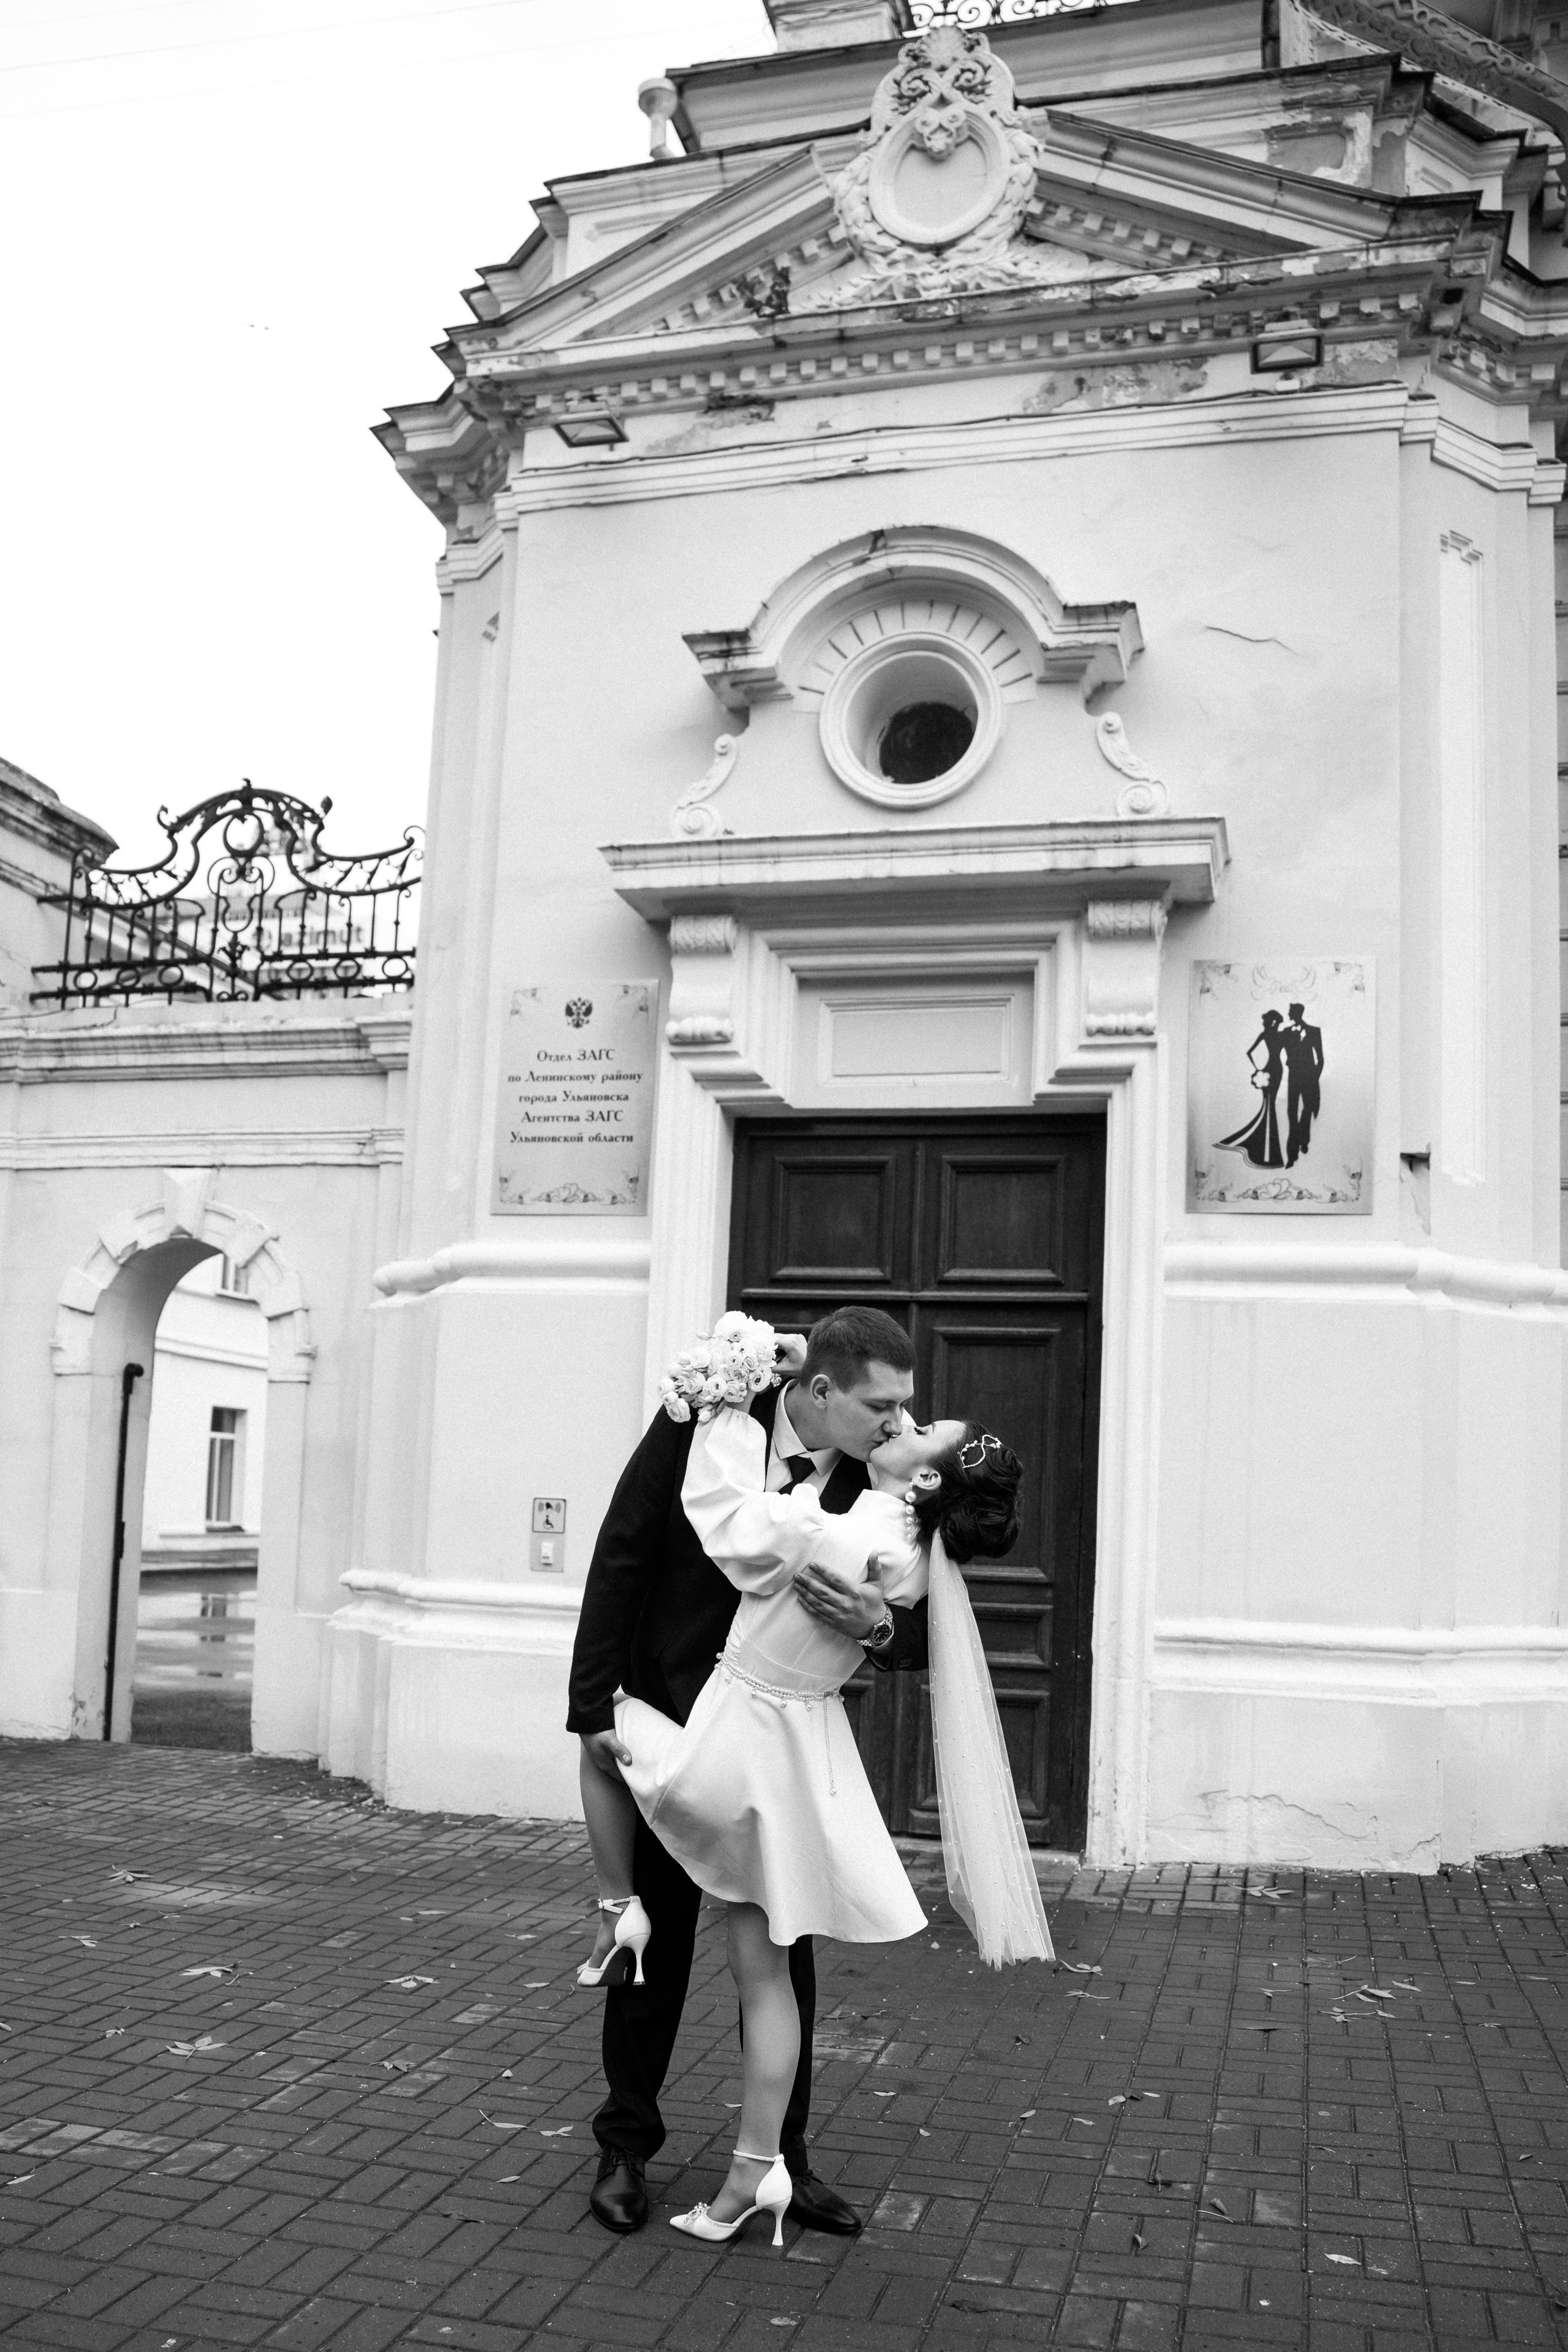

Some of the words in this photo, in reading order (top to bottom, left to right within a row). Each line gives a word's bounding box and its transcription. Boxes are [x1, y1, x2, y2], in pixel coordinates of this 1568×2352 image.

[537, 1050, 572, 1062] Отдел
[577, 1049, 615, 1061] ЗАГС
[525, 1071, 597, 1084] Ленинскому
[601, 1070, 643, 1084] району
[519, 1095, 557, 1104] города
[562, 1090, 629, 1102] Ульяновска
[521, 1111, 581, 1123] Агентства
[585, 1110, 624, 1123] ЗАГС
[510, 1131, 584, 1143] Ульяновской
[587, 1133, 633, 1143] области
